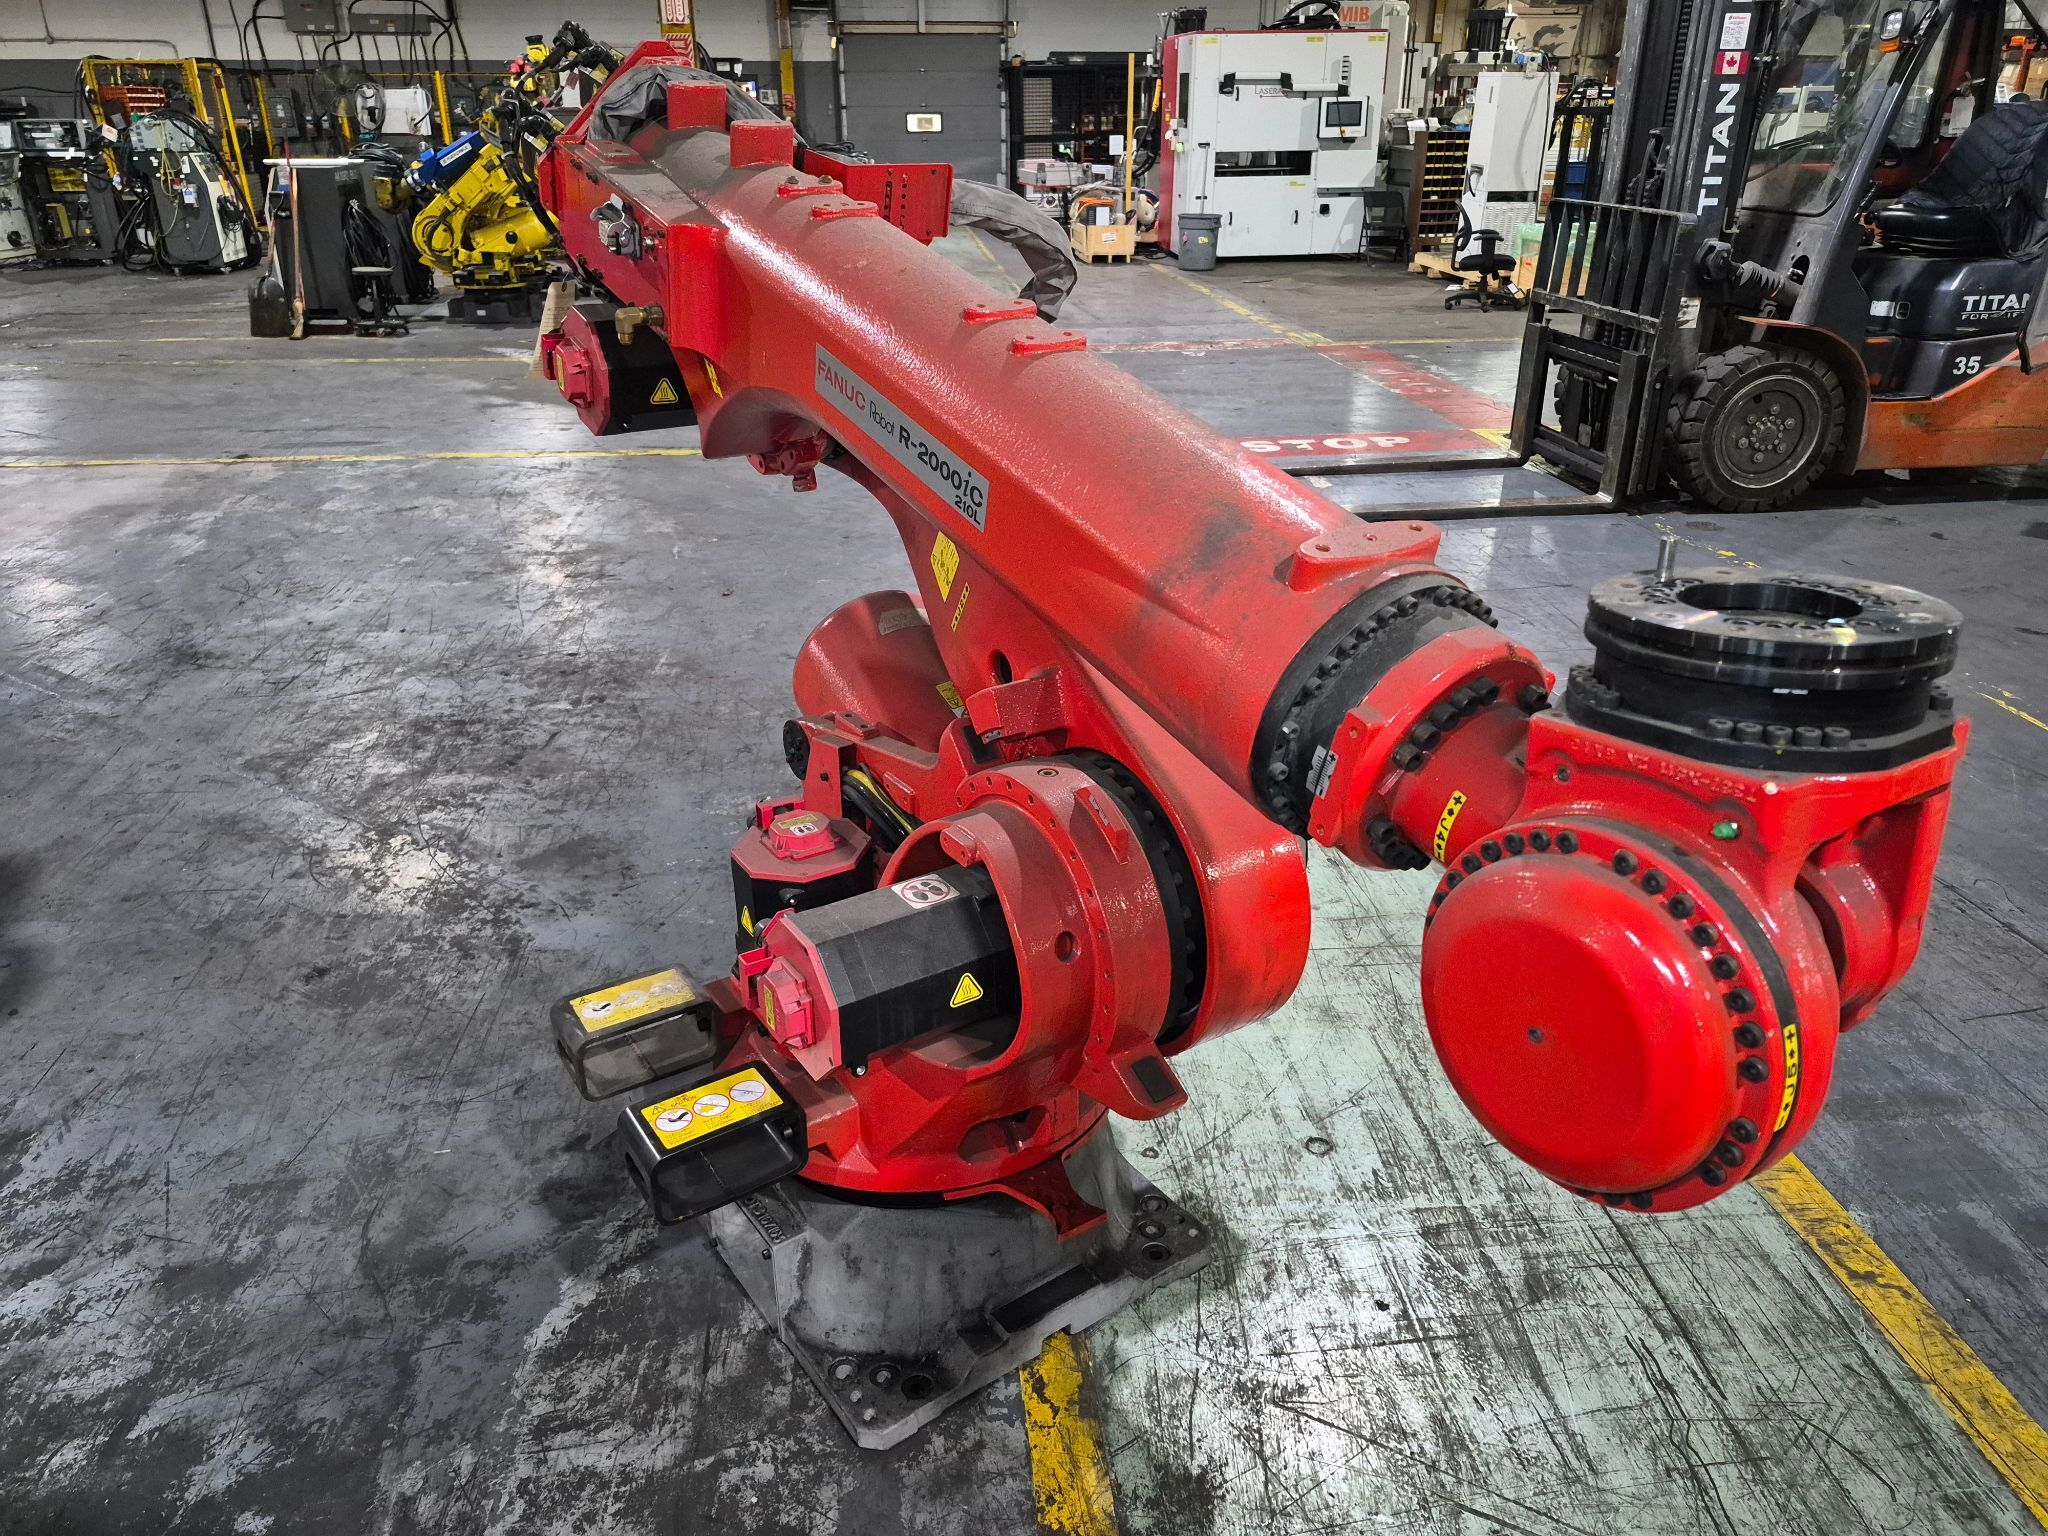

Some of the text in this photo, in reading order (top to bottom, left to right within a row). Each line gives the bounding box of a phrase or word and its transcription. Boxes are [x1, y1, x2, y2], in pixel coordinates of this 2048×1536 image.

[1254, 84, 1288, 95] LASERA
[1696, 83, 1741, 216] TITAN
[1952, 355, 1982, 375] 35
[817, 358, 984, 508] FANUC Robot R-2000iC
[1240, 436, 1411, 453] STOP
[954, 495, 982, 526] 210L
[1436, 817, 1449, 842] J4
[1786, 1062, 1798, 1097] J5
